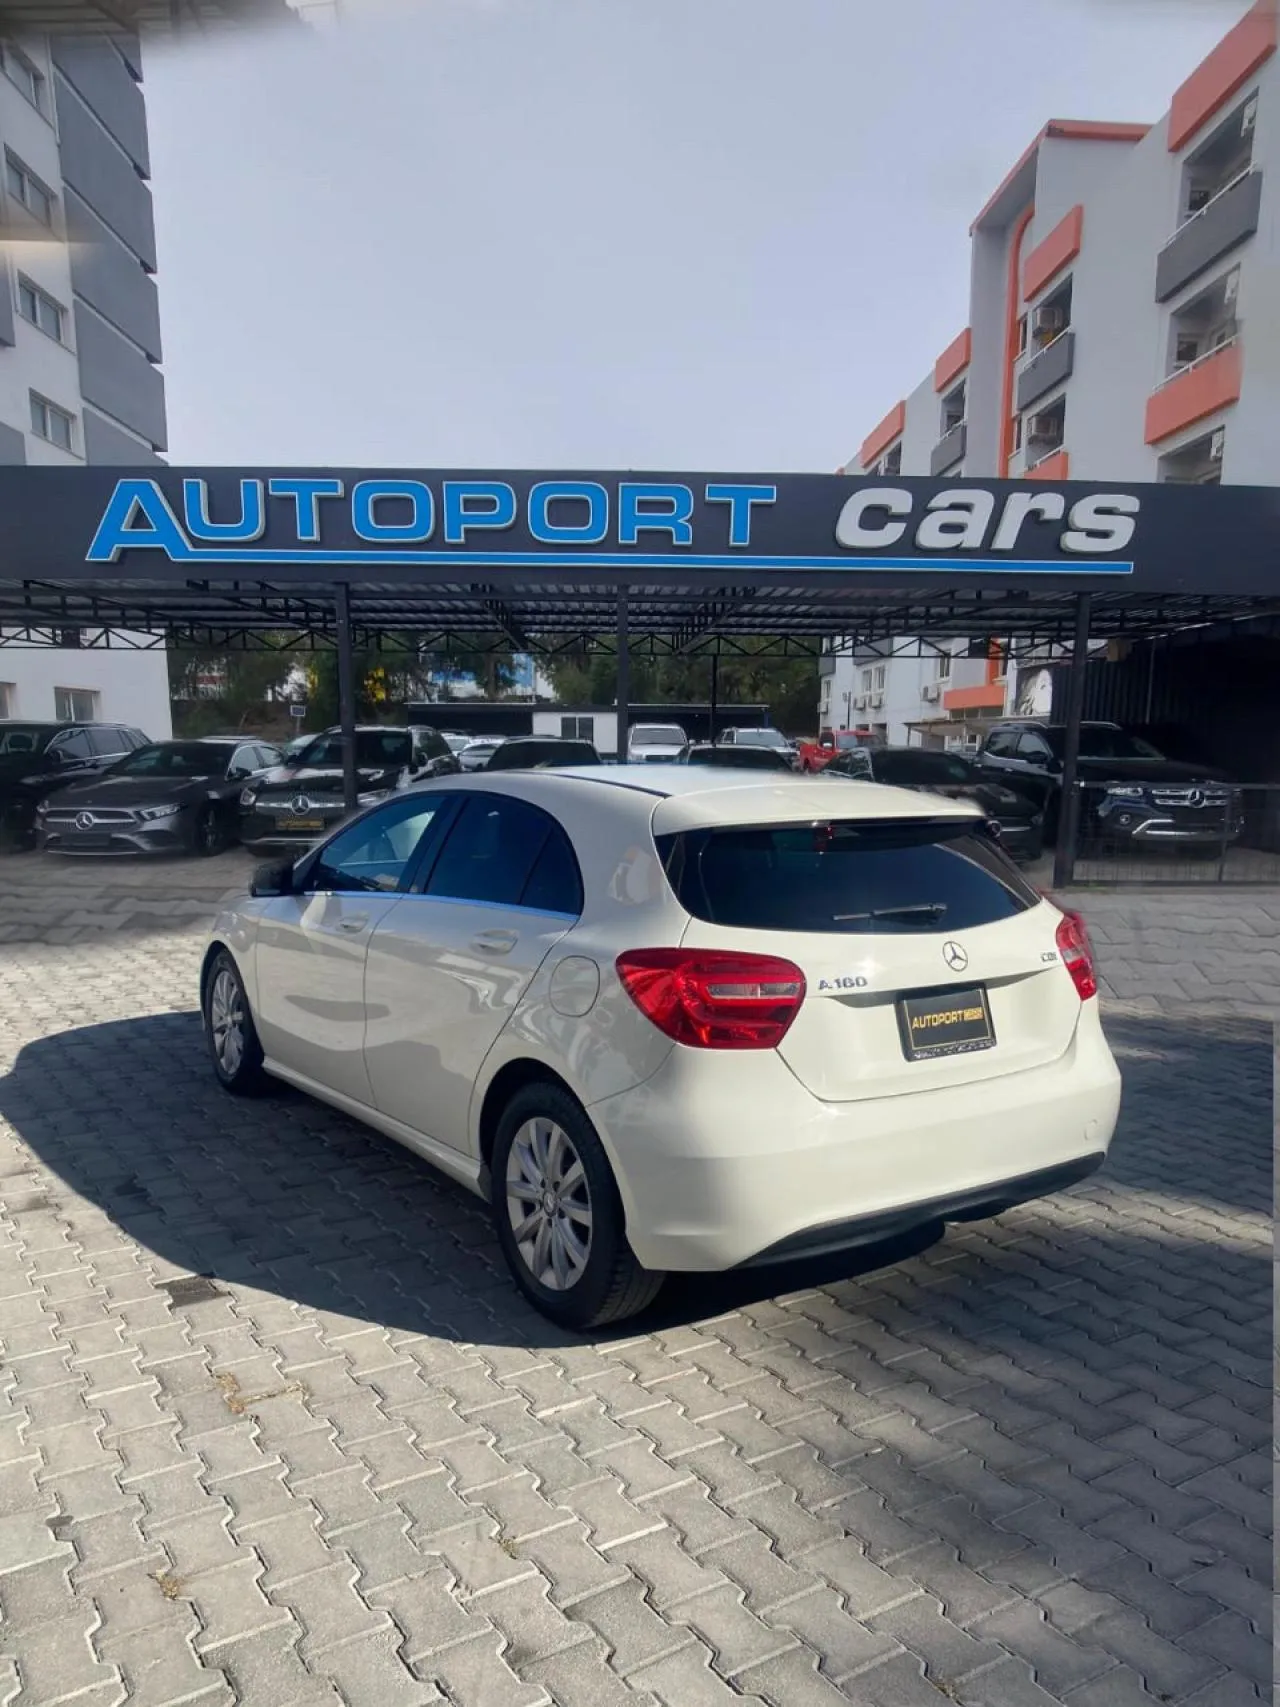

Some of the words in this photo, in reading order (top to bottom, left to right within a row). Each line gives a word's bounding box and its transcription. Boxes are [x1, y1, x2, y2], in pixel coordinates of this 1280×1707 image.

[86, 478, 778, 563] AUTOPORT
[835, 486, 1140, 553] cars
[912, 1010, 964, 1029] AUTOPORT
